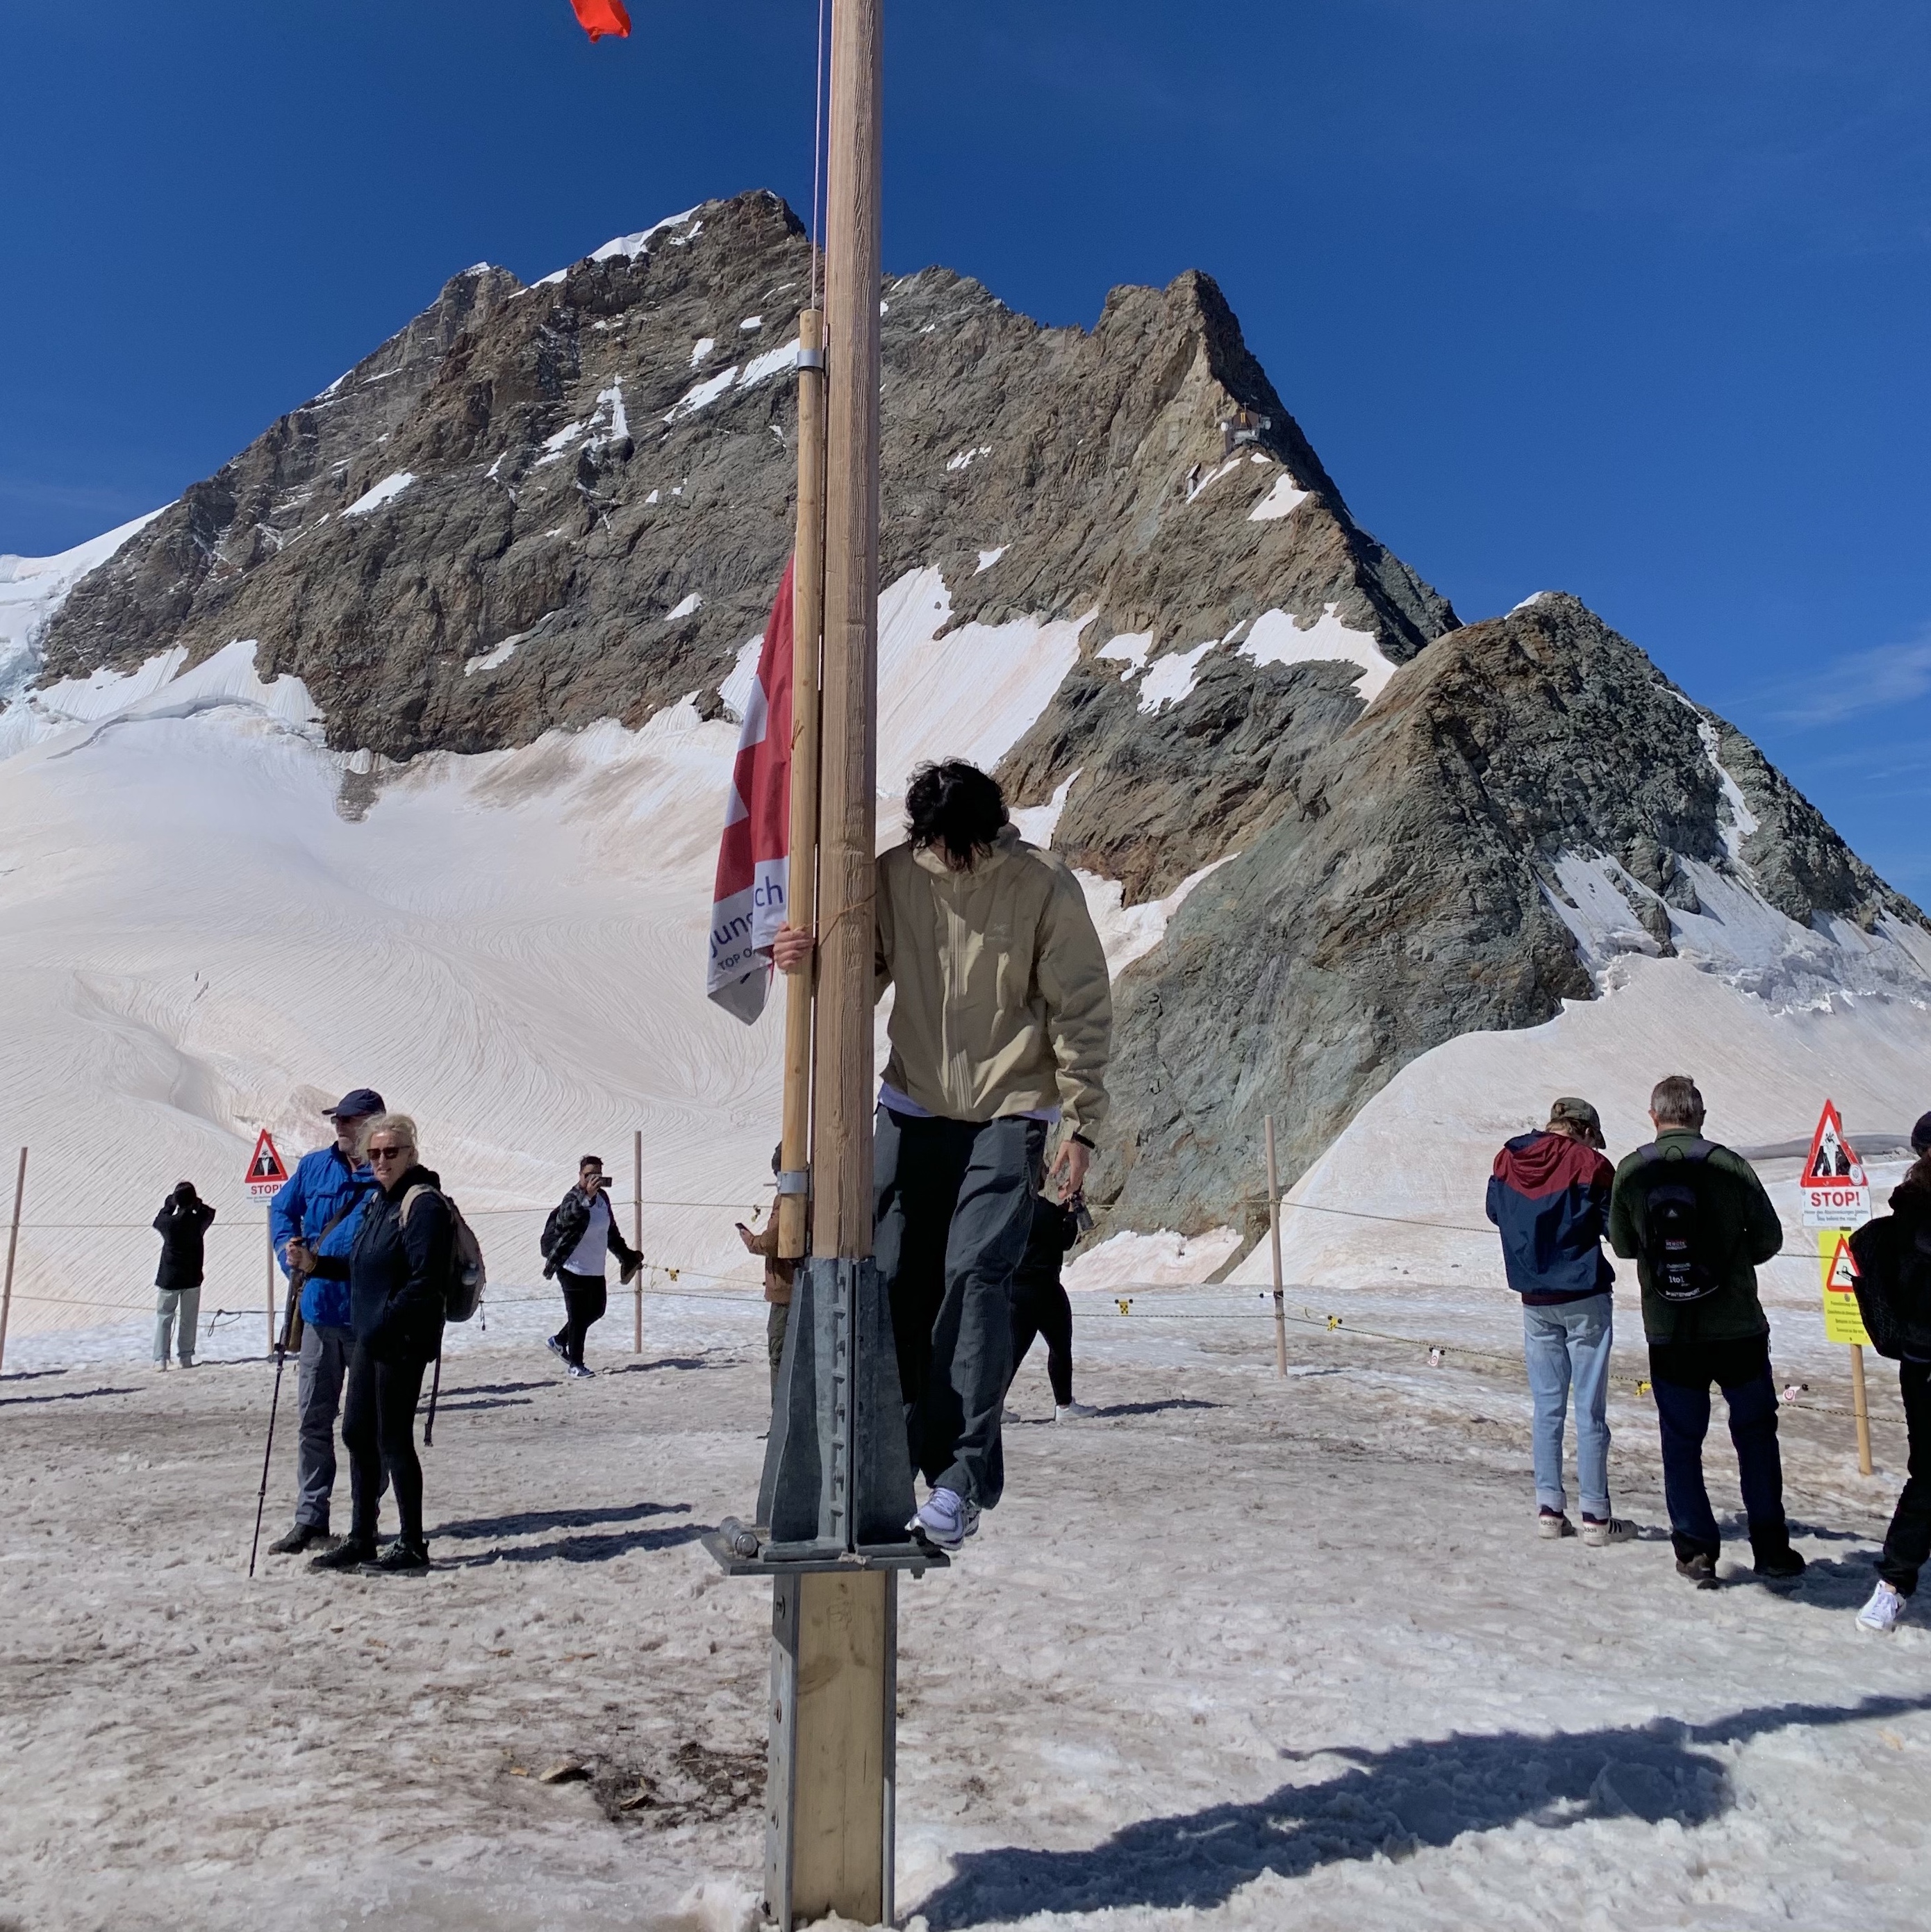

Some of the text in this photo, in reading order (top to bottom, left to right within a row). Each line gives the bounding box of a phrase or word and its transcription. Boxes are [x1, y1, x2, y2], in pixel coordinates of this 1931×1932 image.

[754, 876, 784, 907] ch
[718, 954, 740, 971] TOP
[1811, 1191, 1861, 1207] STOP!
